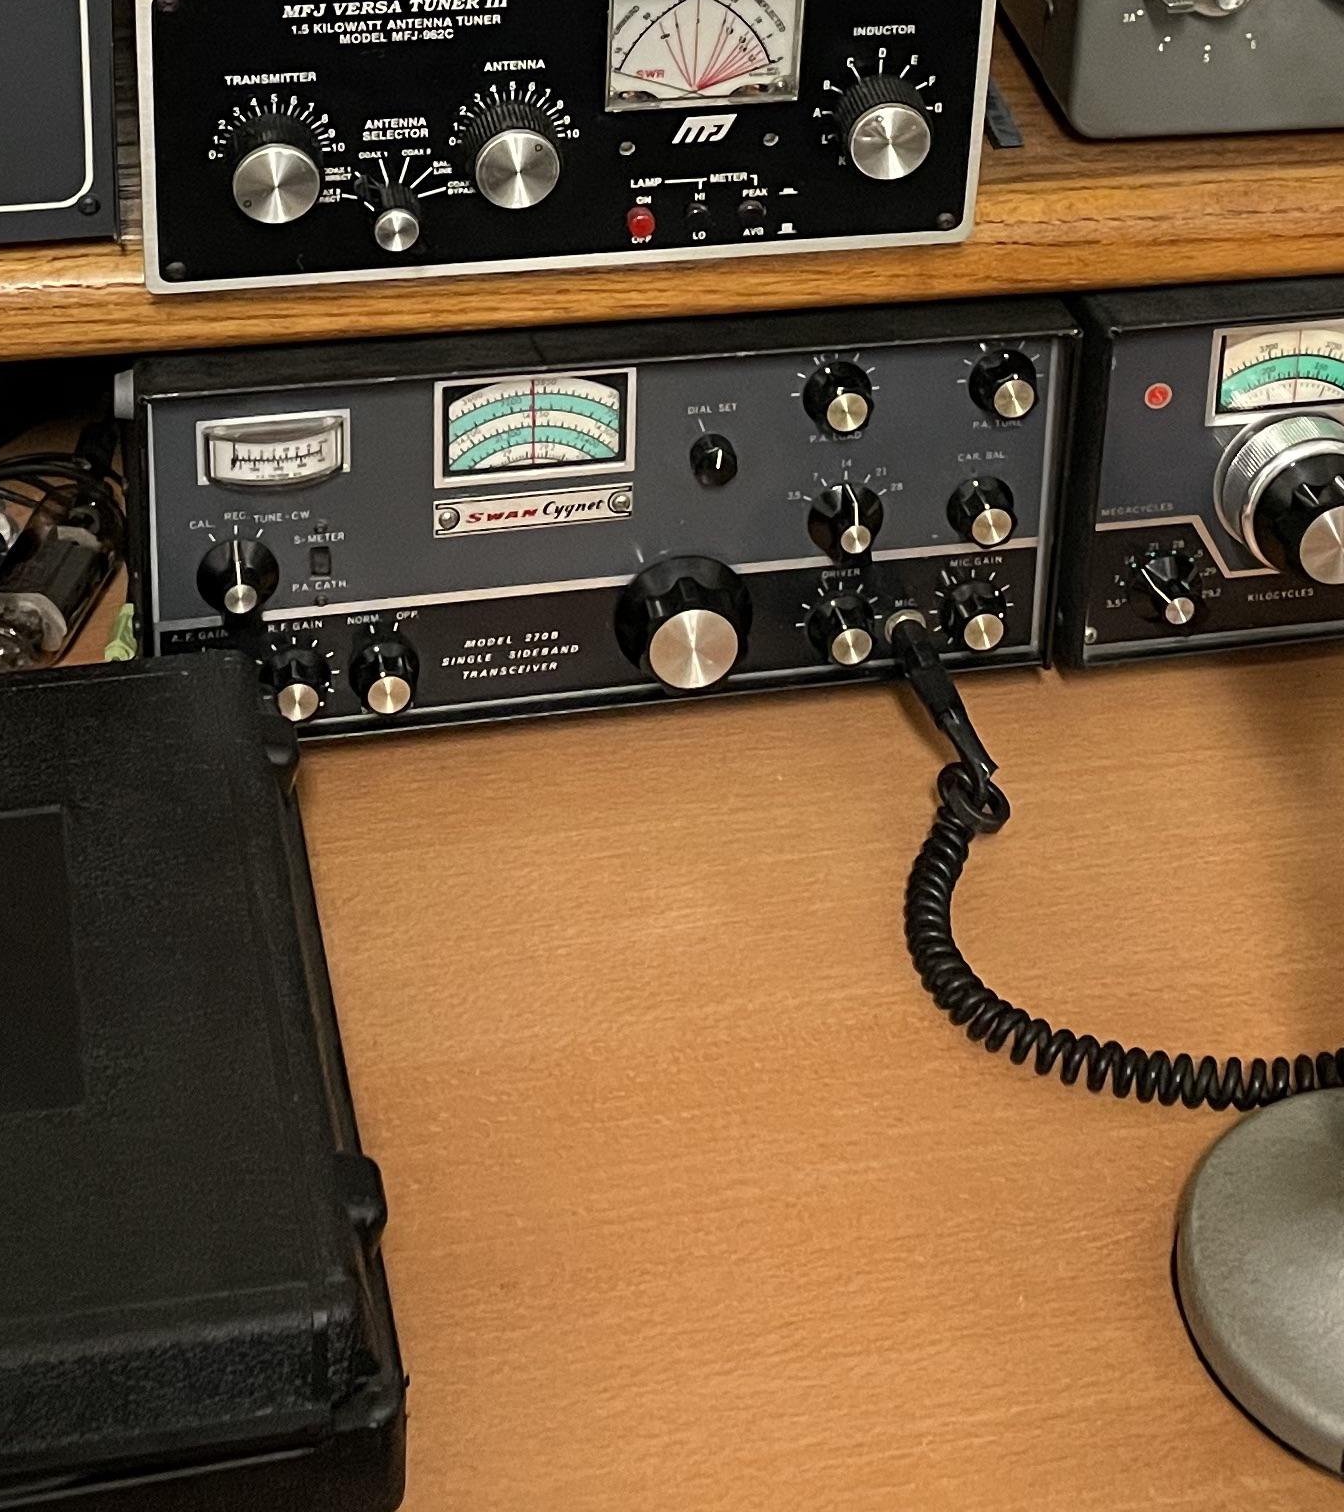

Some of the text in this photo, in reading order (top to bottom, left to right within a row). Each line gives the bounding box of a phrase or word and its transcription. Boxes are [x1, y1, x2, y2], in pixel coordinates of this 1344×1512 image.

[282, 4, 326, 19] MFJ
[332, 0, 402, 16] VERSA
[312, 14, 502, 34] KILOWATT ANTENNA TUNER
[853, 24, 916, 37] INDUCTOR
[338, 32, 388, 44] MODEL
[483, 59, 546, 73] ANTENNA
[224, 71, 317, 86] TRANSMITTER
[635, 69, 666, 79] SWR
[363, 117, 428, 130] ANTENNA
[362, 128, 430, 141] SELECTOR
[630, 177, 662, 189] LAMP
[709, 172, 748, 183] METER
[742, 188, 768, 198] PEAK
[687, 402, 738, 416] DIAL SET
[466, 498, 605, 524] SWAN Cygnet
[1101, 501, 1175, 517] MEGACYCLES
[253, 509, 311, 524] TUNE-CW
[293, 531, 346, 545] S-METER
[975, 555, 1003, 566] GAIN
[821, 567, 861, 579] DRIVER
[1247, 587, 1315, 602] KILOCYCLES
[292, 620, 324, 631] GAIN
[463, 635, 513, 649] MODEL
[441, 644, 580, 667] SINGLE SIDEBAND
[461, 661, 559, 680] TRANSCEIVER
